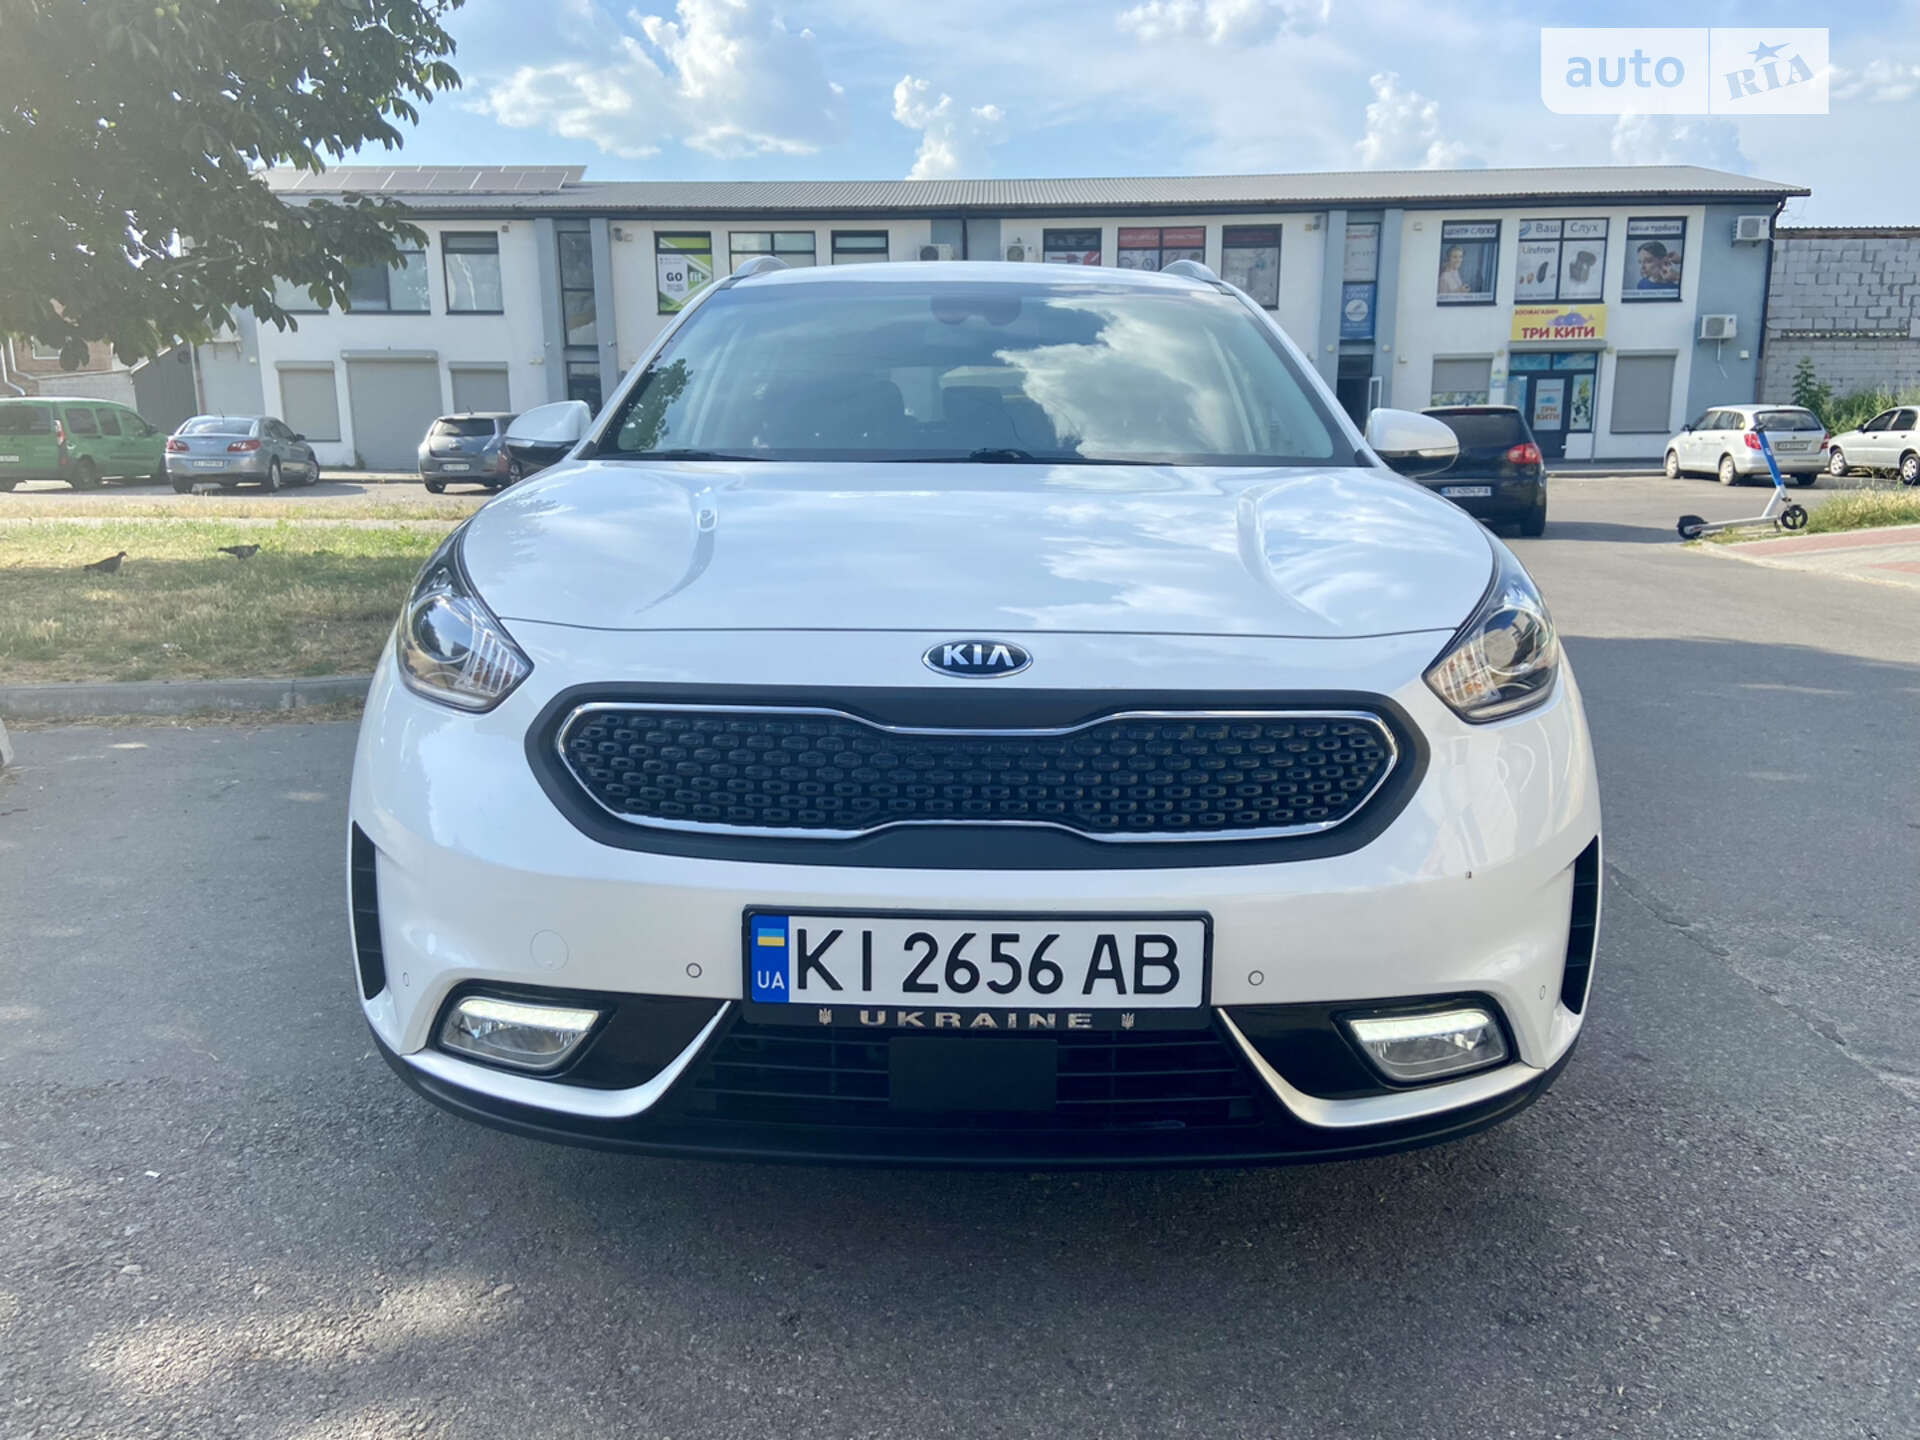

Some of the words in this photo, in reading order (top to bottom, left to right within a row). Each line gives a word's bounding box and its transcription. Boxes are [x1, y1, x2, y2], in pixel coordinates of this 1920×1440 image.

[1535, 223, 1560, 233] Ваш
[1570, 222, 1599, 234] Слух
[666, 272, 683, 282] GO
[1521, 326, 1551, 339] ТРИ
[1554, 326, 1596, 339] КИТИ
[943, 643, 1016, 667] KIA
[797, 928, 873, 992] KI
[902, 932, 1064, 994] 2656
[1082, 933, 1181, 995] AB
[757, 969, 786, 990] UA
[859, 1009, 1093, 1029] UKRAINE
